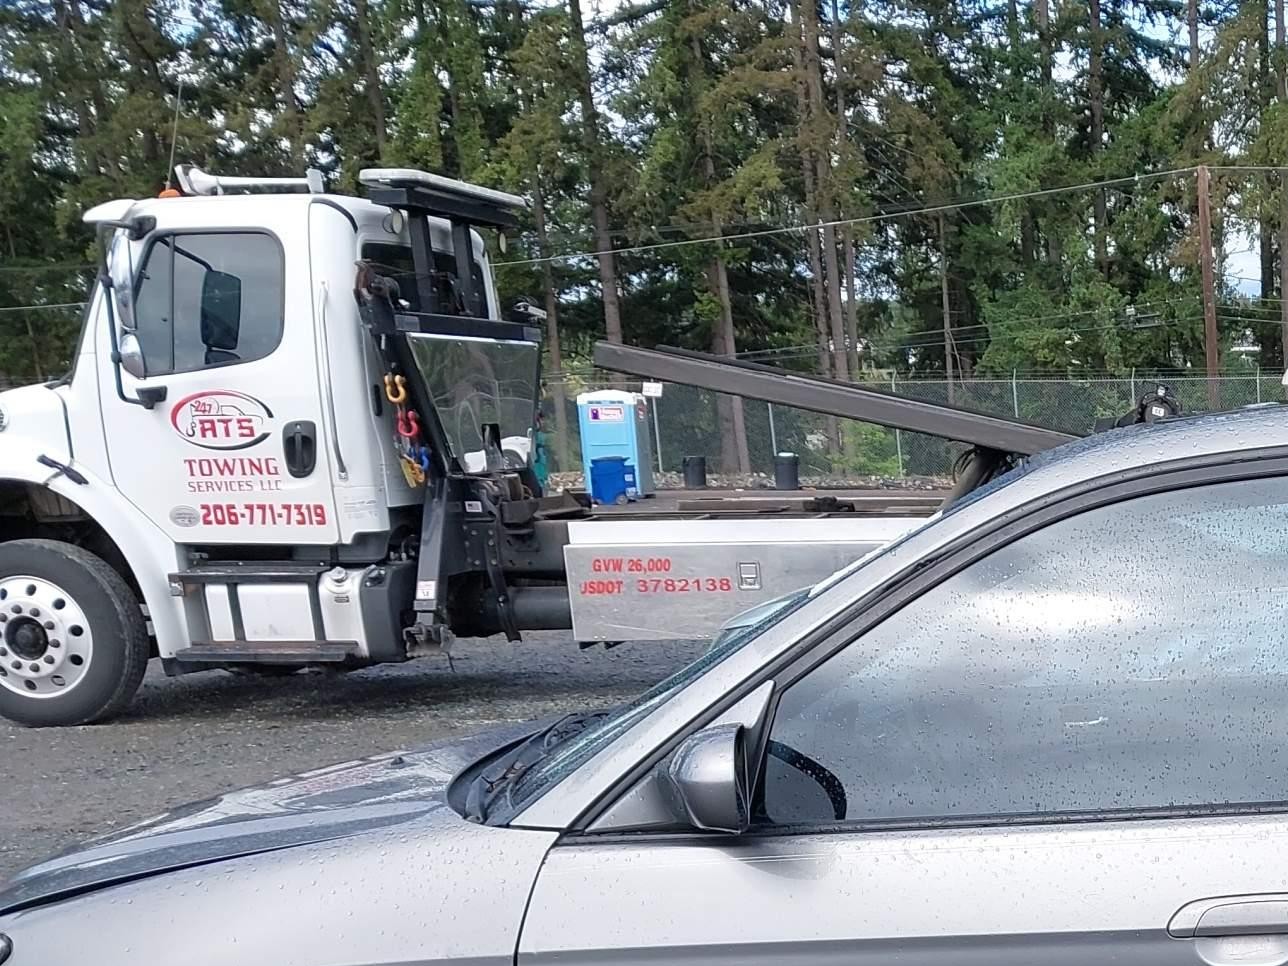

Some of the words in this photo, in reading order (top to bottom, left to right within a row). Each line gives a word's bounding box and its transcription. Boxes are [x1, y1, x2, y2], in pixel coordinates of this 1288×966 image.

[198, 418, 255, 438] ATS
[184, 457, 280, 476] TOWING
[188, 480, 254, 493] SERVICES
[260, 479, 282, 491] LLC
[200, 503, 327, 526] 206-771-7319
[592, 559, 623, 572] GVW
[627, 558, 671, 574] 26,000
[637, 578, 732, 593] 3782138
